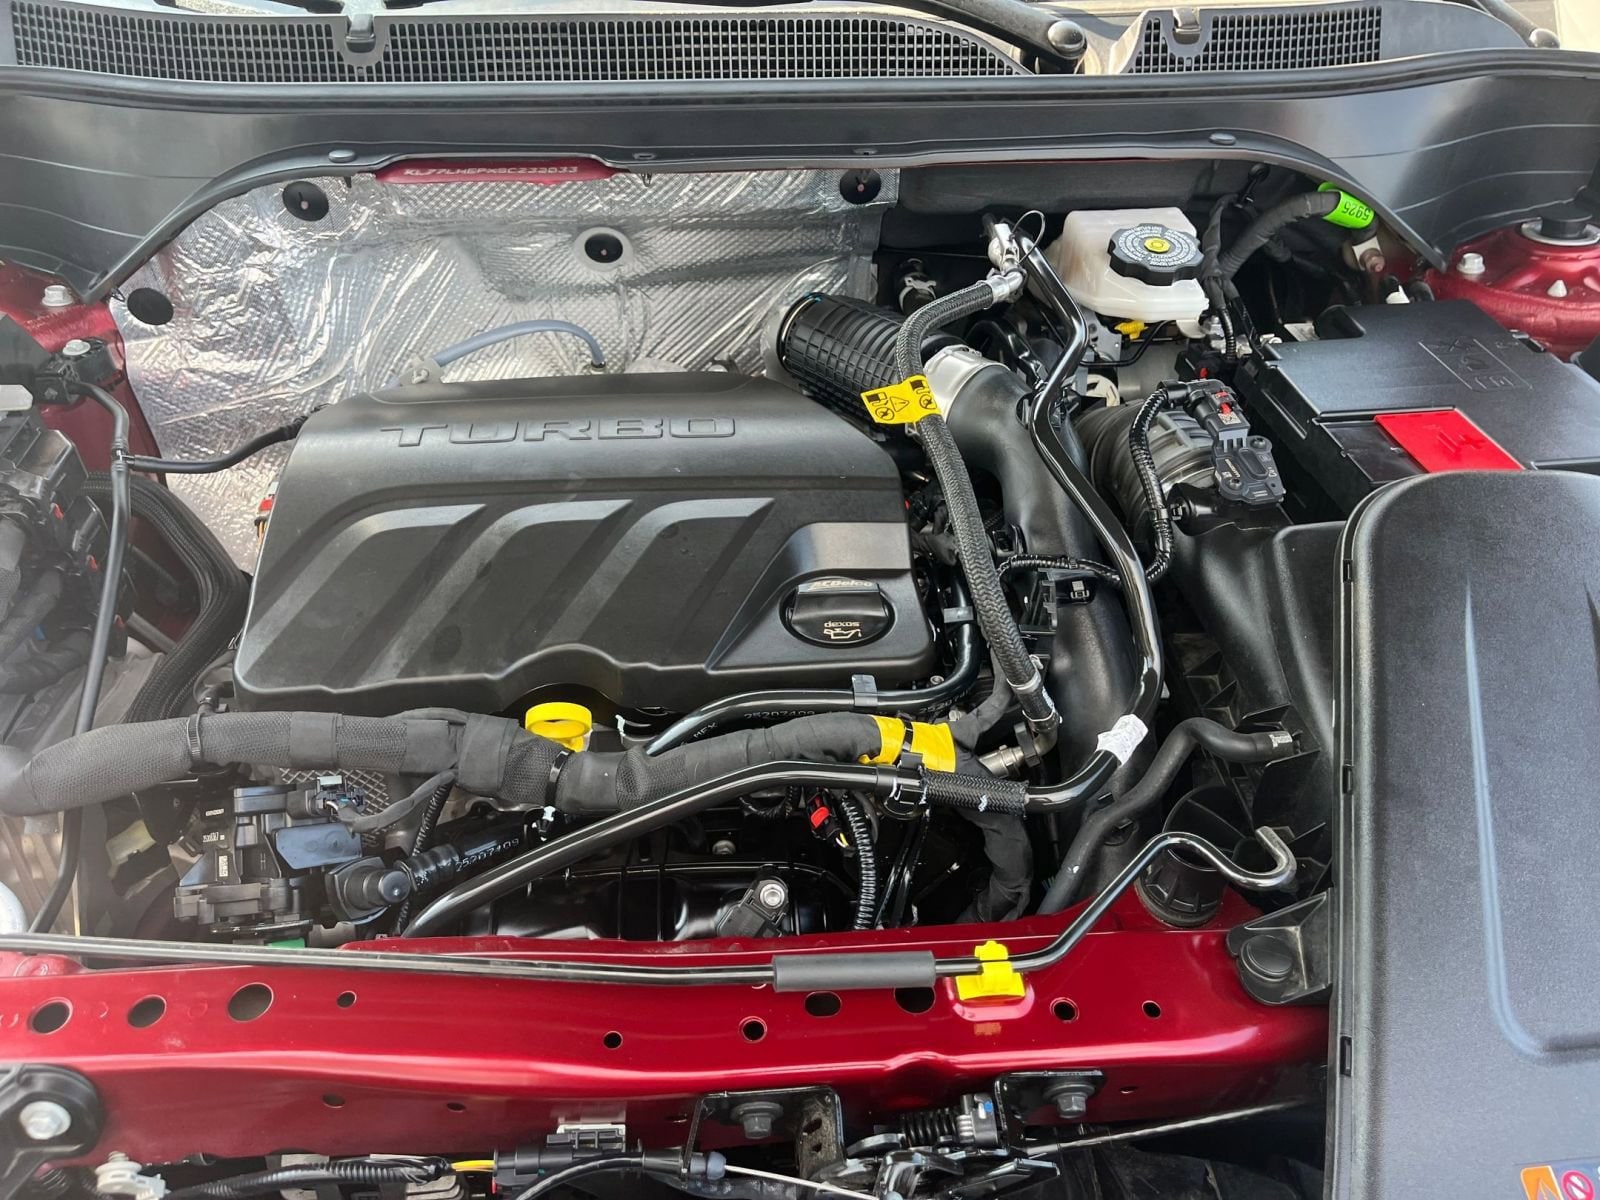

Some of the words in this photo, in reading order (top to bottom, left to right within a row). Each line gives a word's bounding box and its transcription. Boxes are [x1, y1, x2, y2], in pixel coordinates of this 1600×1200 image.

[1341, 201, 1371, 220] 5925
[380, 417, 736, 447] TURBO
[809, 580, 873, 590] ACDelco
